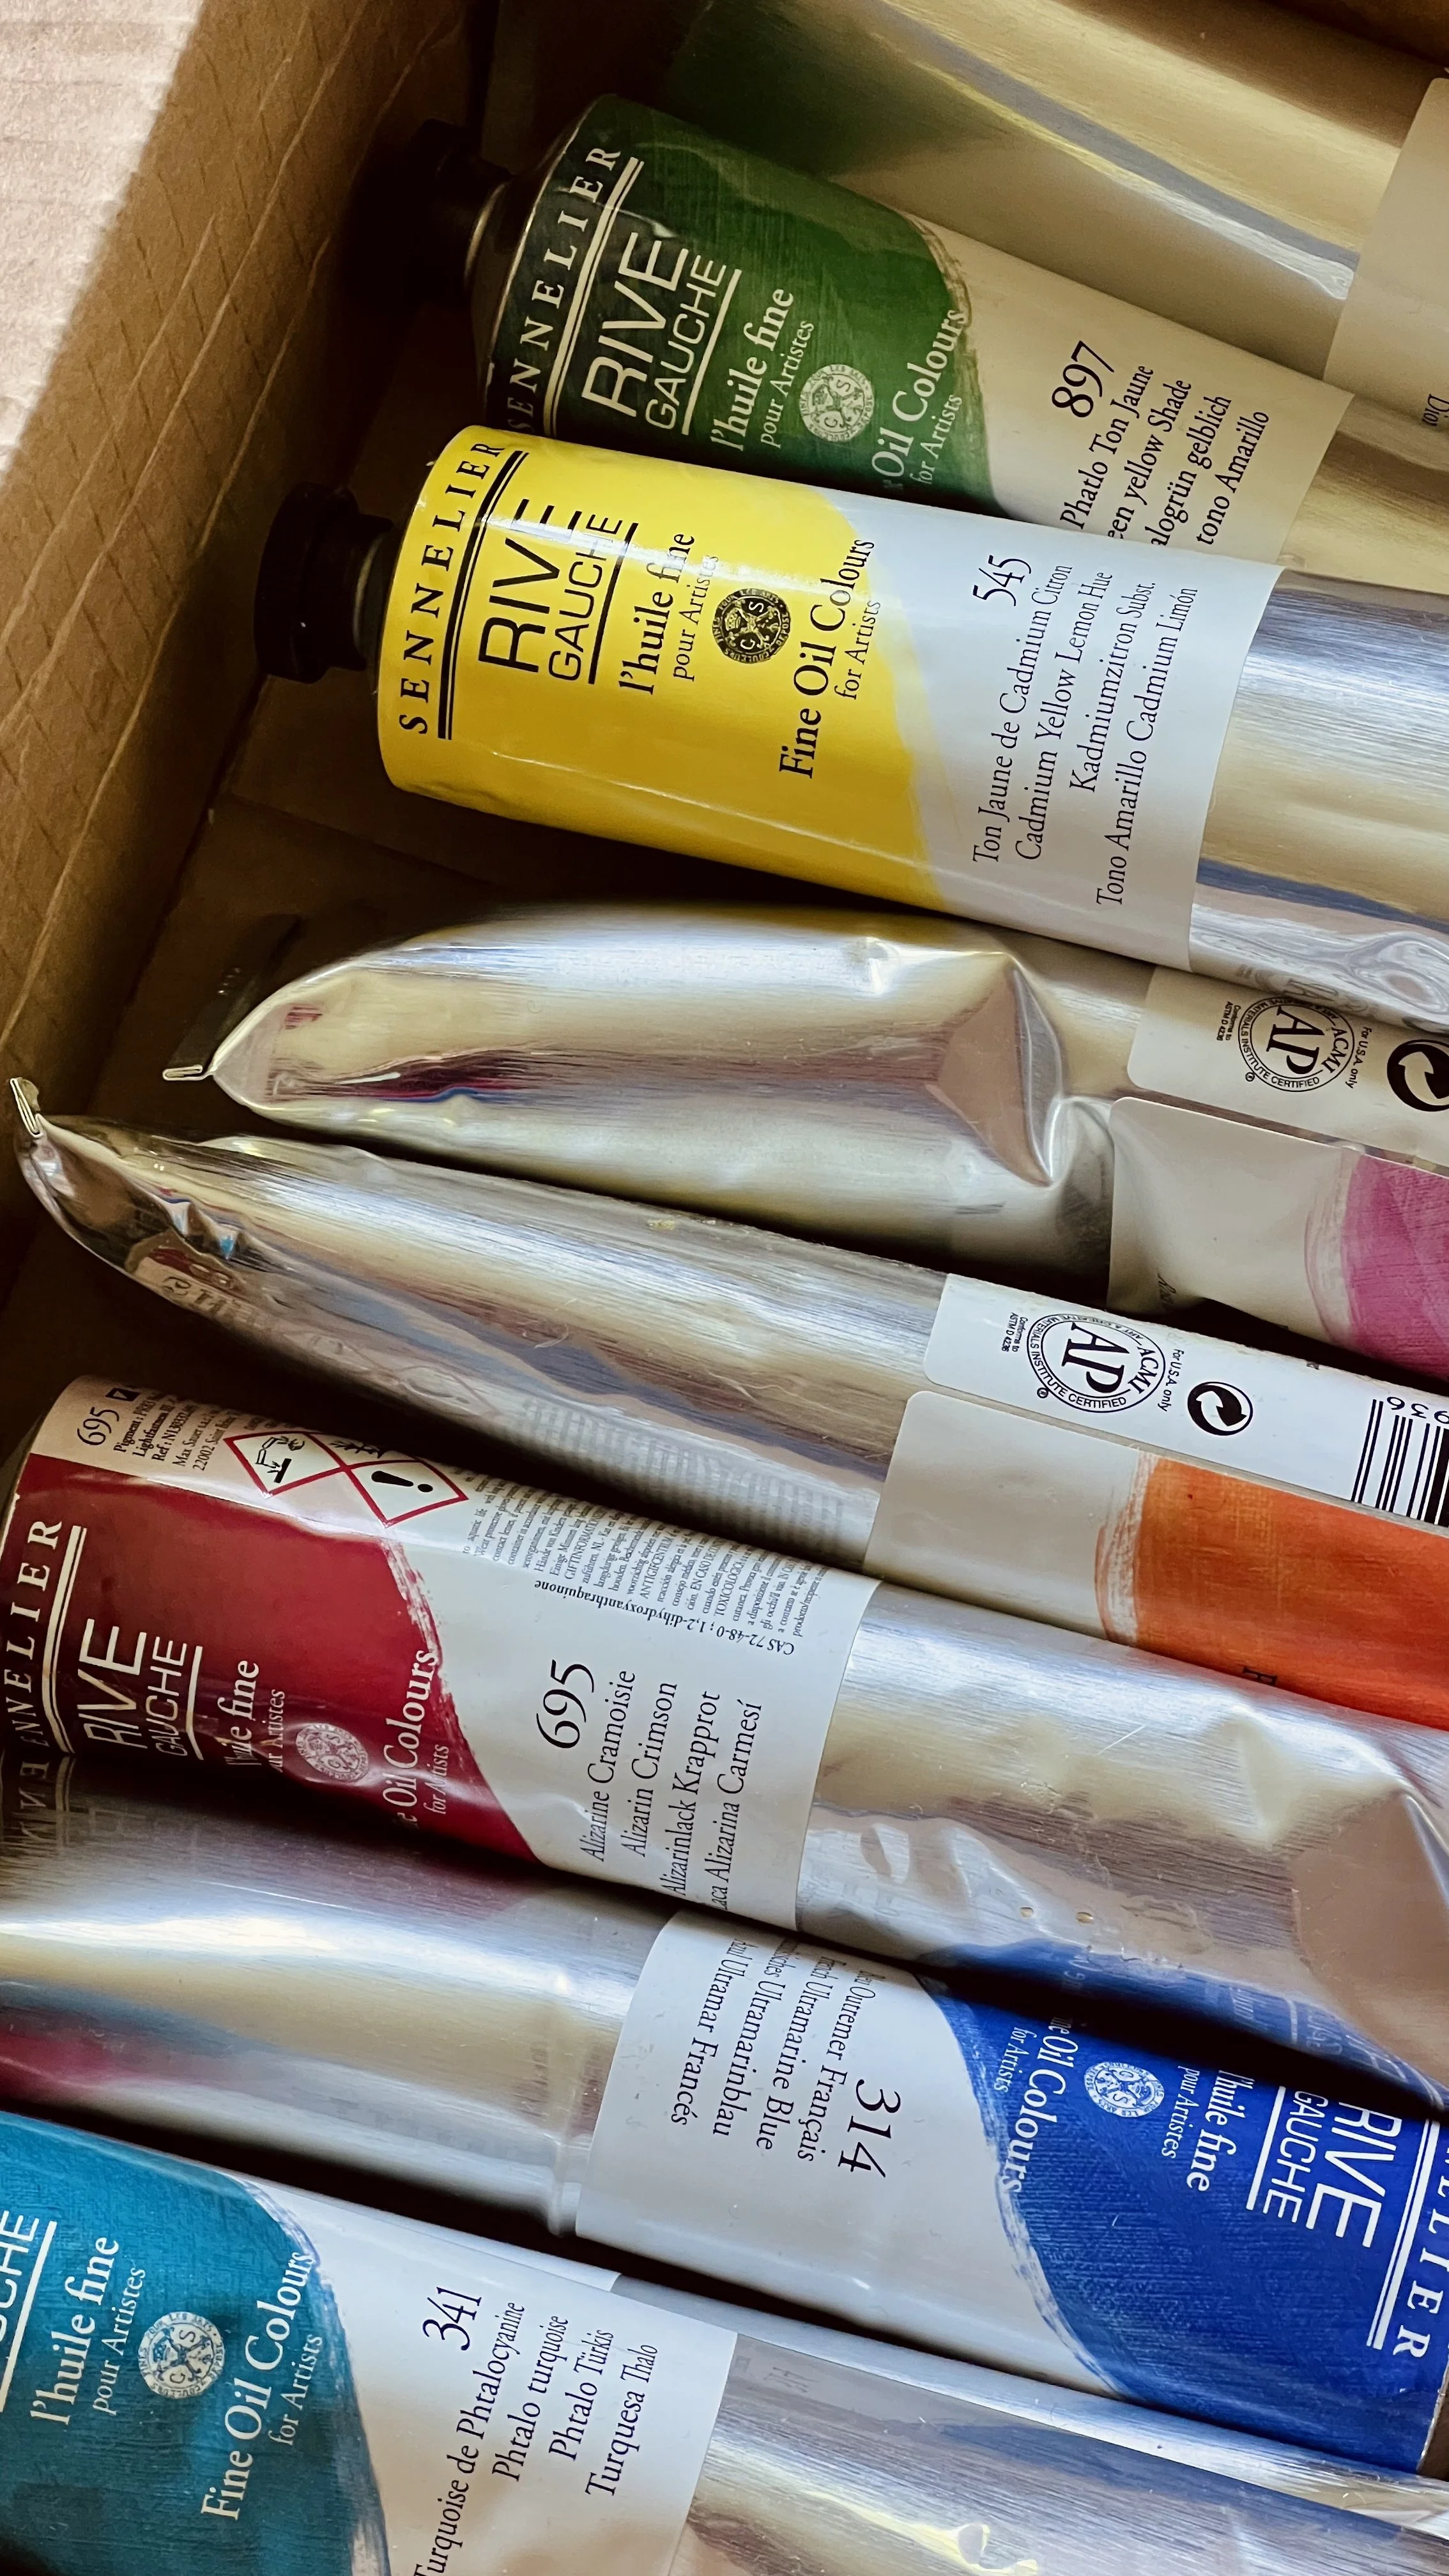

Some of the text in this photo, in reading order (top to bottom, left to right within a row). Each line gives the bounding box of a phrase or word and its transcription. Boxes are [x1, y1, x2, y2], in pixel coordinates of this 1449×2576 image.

[505, 146, 622, 434] SENNELIER
[581, 231, 689, 417] RIVE
[645, 254, 726, 429] GAUCHE
[710, 288, 794, 450] l'huile fine
[761, 320, 814, 448] pour Artistes
[871, 309, 969, 479] Oil Colours
[1052, 341, 1114, 417] 897
[909, 393, 963, 485] for Artists
[1060, 365, 1153, 530] Phatlo Ton Jaune
[1124, 434, 1164, 505] yellow
[1149, 379, 1192, 433] Shade
[1189, 396, 1232, 470] gelblich
[1197, 411, 1269, 545] tono Amarillo
[399, 442, 505, 735] SENNELIER
[479, 498, 581, 673] RIVE
[549, 514, 622, 682] GAUCHE
[618, 533, 694, 695] l'huile fine
[973, 555, 1032, 606] 545
[673, 634, 700, 682] pour
[779, 540, 875, 779] Fine Oil Colours
[835, 601, 881, 701] for Artists
[1069, 582, 1156, 792] Kadmiumzitron Subst.
[973, 565, 1073, 862] Ton Jaune de Cadmium Citron
[1016, 571, 1113, 860] Cadmium Yellow Lemon Hue
[1096, 588, 1198, 905] Tono Amarillo Cadmium Limón
[1241, 1038, 1271, 1080] INSTITUTE
[1271, 1075, 1321, 1088] CERTIFIED
[1266, 1006, 1325, 1075] AP
[1321, 1027, 1349, 1074] ACMI
[1346, 1068, 1358, 1089] only
[1031, 1351, 1070, 1397] INSTITUTE
[1068, 1393, 1128, 1409] CERTIFIED
[1061, 1321, 1130, 1393] AP
[1128, 1346, 1160, 1395] ACMI
[1157, 1389, 1172, 1412] only
[77, 1406, 119, 1446] 695
[3, 1521, 62, 1748] ENNELIER
[77, 1618, 148, 1749] RIVE
[217, 1660, 259, 1721] fine
[716, 1623, 766, 1649] 72-48-0
[768, 1641, 795, 1656] CAS
[146, 1636, 187, 1757] GAUCHE
[383, 1650, 439, 1769] Colours
[537, 1659, 595, 1749] 695
[673, 1690, 721, 1797] Krapprot
[716, 1698, 762, 1796] Carmesí
[383, 1777, 417, 1807] Oil
[424, 1790, 447, 1815] for
[580, 1670, 636, 1862] Alizarine Cramoisie
[620, 1682, 678, 1858] Alizarin Crimson
[703, 1800, 740, 1883] Alizarina
[697, 1959, 746, 2033] Ultramar
[772, 1971, 832, 2089] Ultramarine
[827, 1986, 876, 2064] Outremer
[1036, 2034, 1078, 2067] Oil
[671, 2038, 719, 2126] Francés
[714, 1980, 783, 2136] Ultramarinblau
[798, 2065, 848, 2162] Français
[993, 2027, 1038, 2092] for Artists
[1162, 2066, 1201, 2159] pour Artistes
[756, 2099, 794, 2151] Blue
[837, 2079, 901, 2178] 314
[1000, 2069, 1066, 2194] Colours
[1186, 2126, 1237, 2192] fine
[1263, 2090, 1330, 2223] GAUCHE
[1306, 2101, 1402, 2248] RIVE
[30, 2237, 119, 2425] l'huile fine
[93, 2267, 146, 2416] pour Artistes
[422, 2287, 482, 2352] 341
[456, 2301, 525, 2440] Phtalocyanine
[201, 2251, 316, 2520] Fine Oil Colours
[268, 2333, 323, 2446] for Artists
[492, 2315, 569, 2482] Phtalo turquoise
[548, 2329, 615, 2462] Phtalo Türkis
[585, 2344, 658, 2497] Turquesa Thalo
[447, 2444, 479, 2475] de
